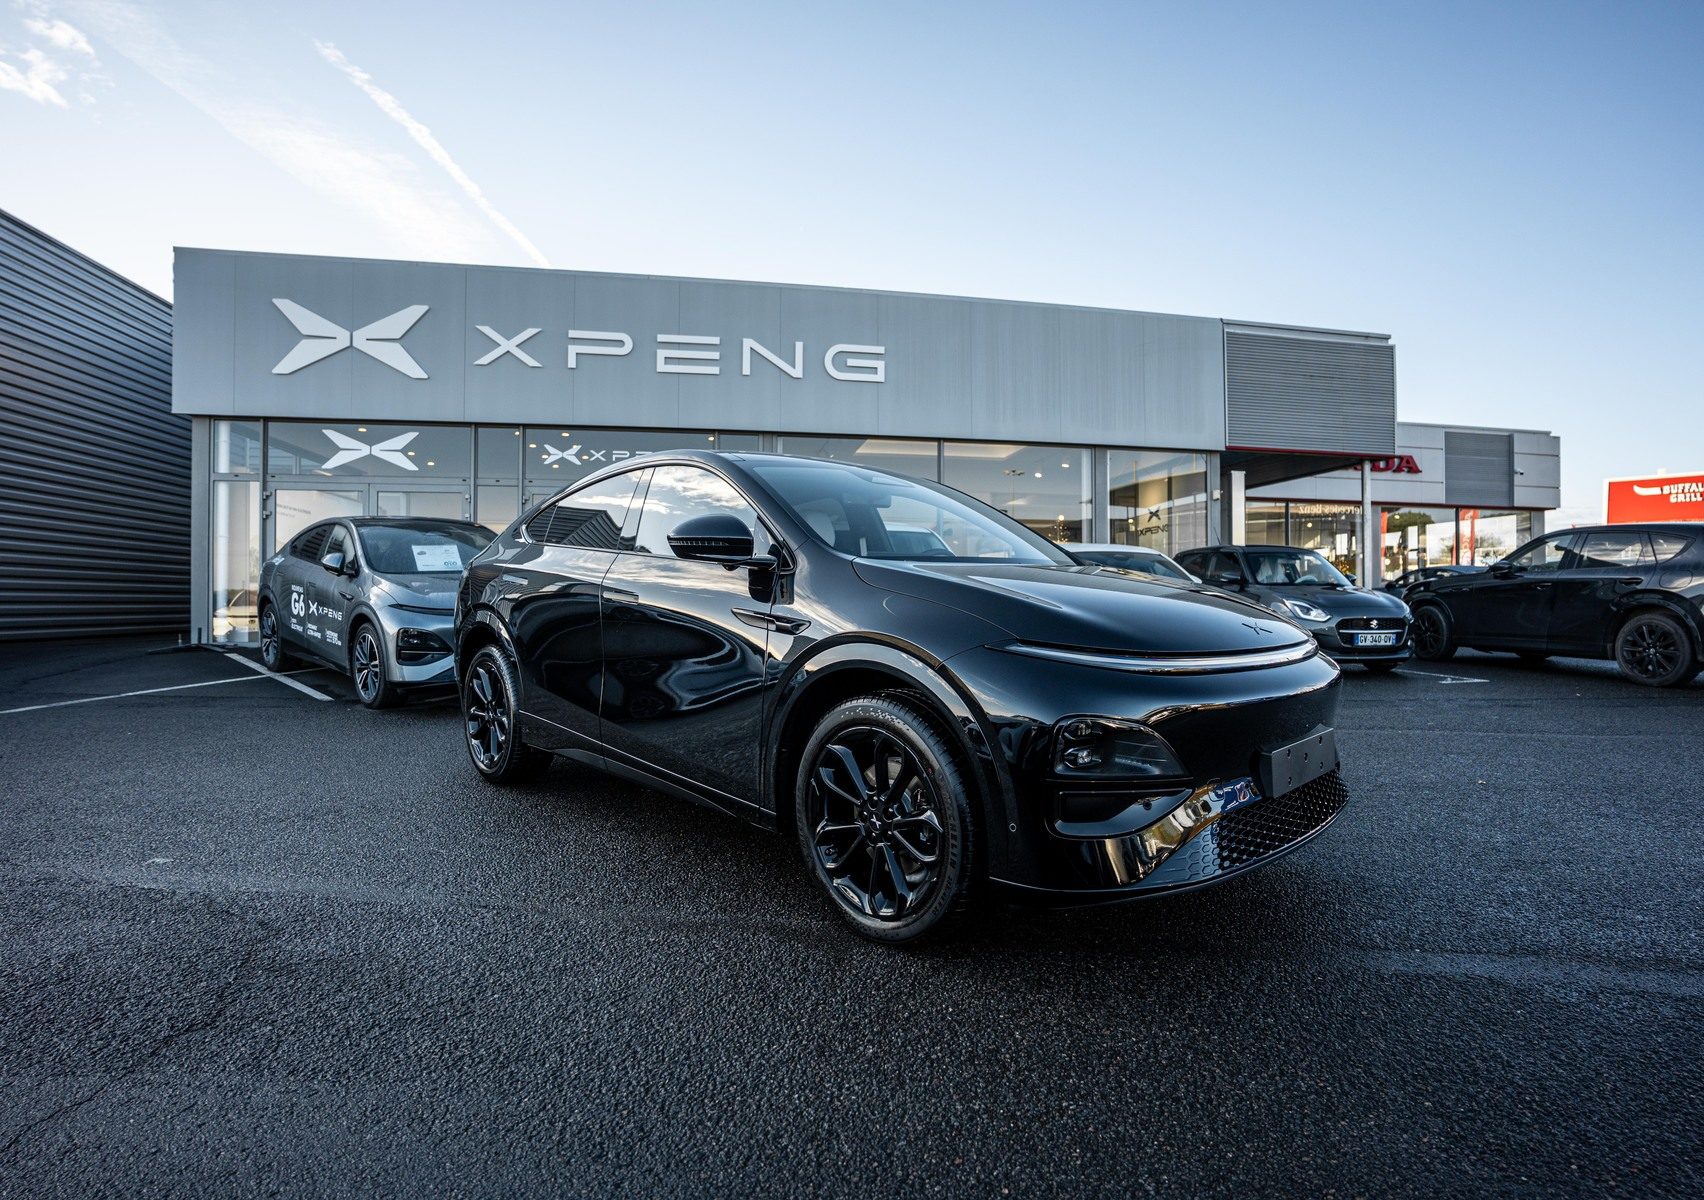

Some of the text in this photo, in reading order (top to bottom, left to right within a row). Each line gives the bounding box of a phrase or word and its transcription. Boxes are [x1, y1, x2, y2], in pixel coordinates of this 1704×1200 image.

[473, 325, 886, 383] XPENG
[1669, 492, 1703, 503] GRILL
[291, 592, 305, 617] G6
[318, 605, 343, 621] XPENG
